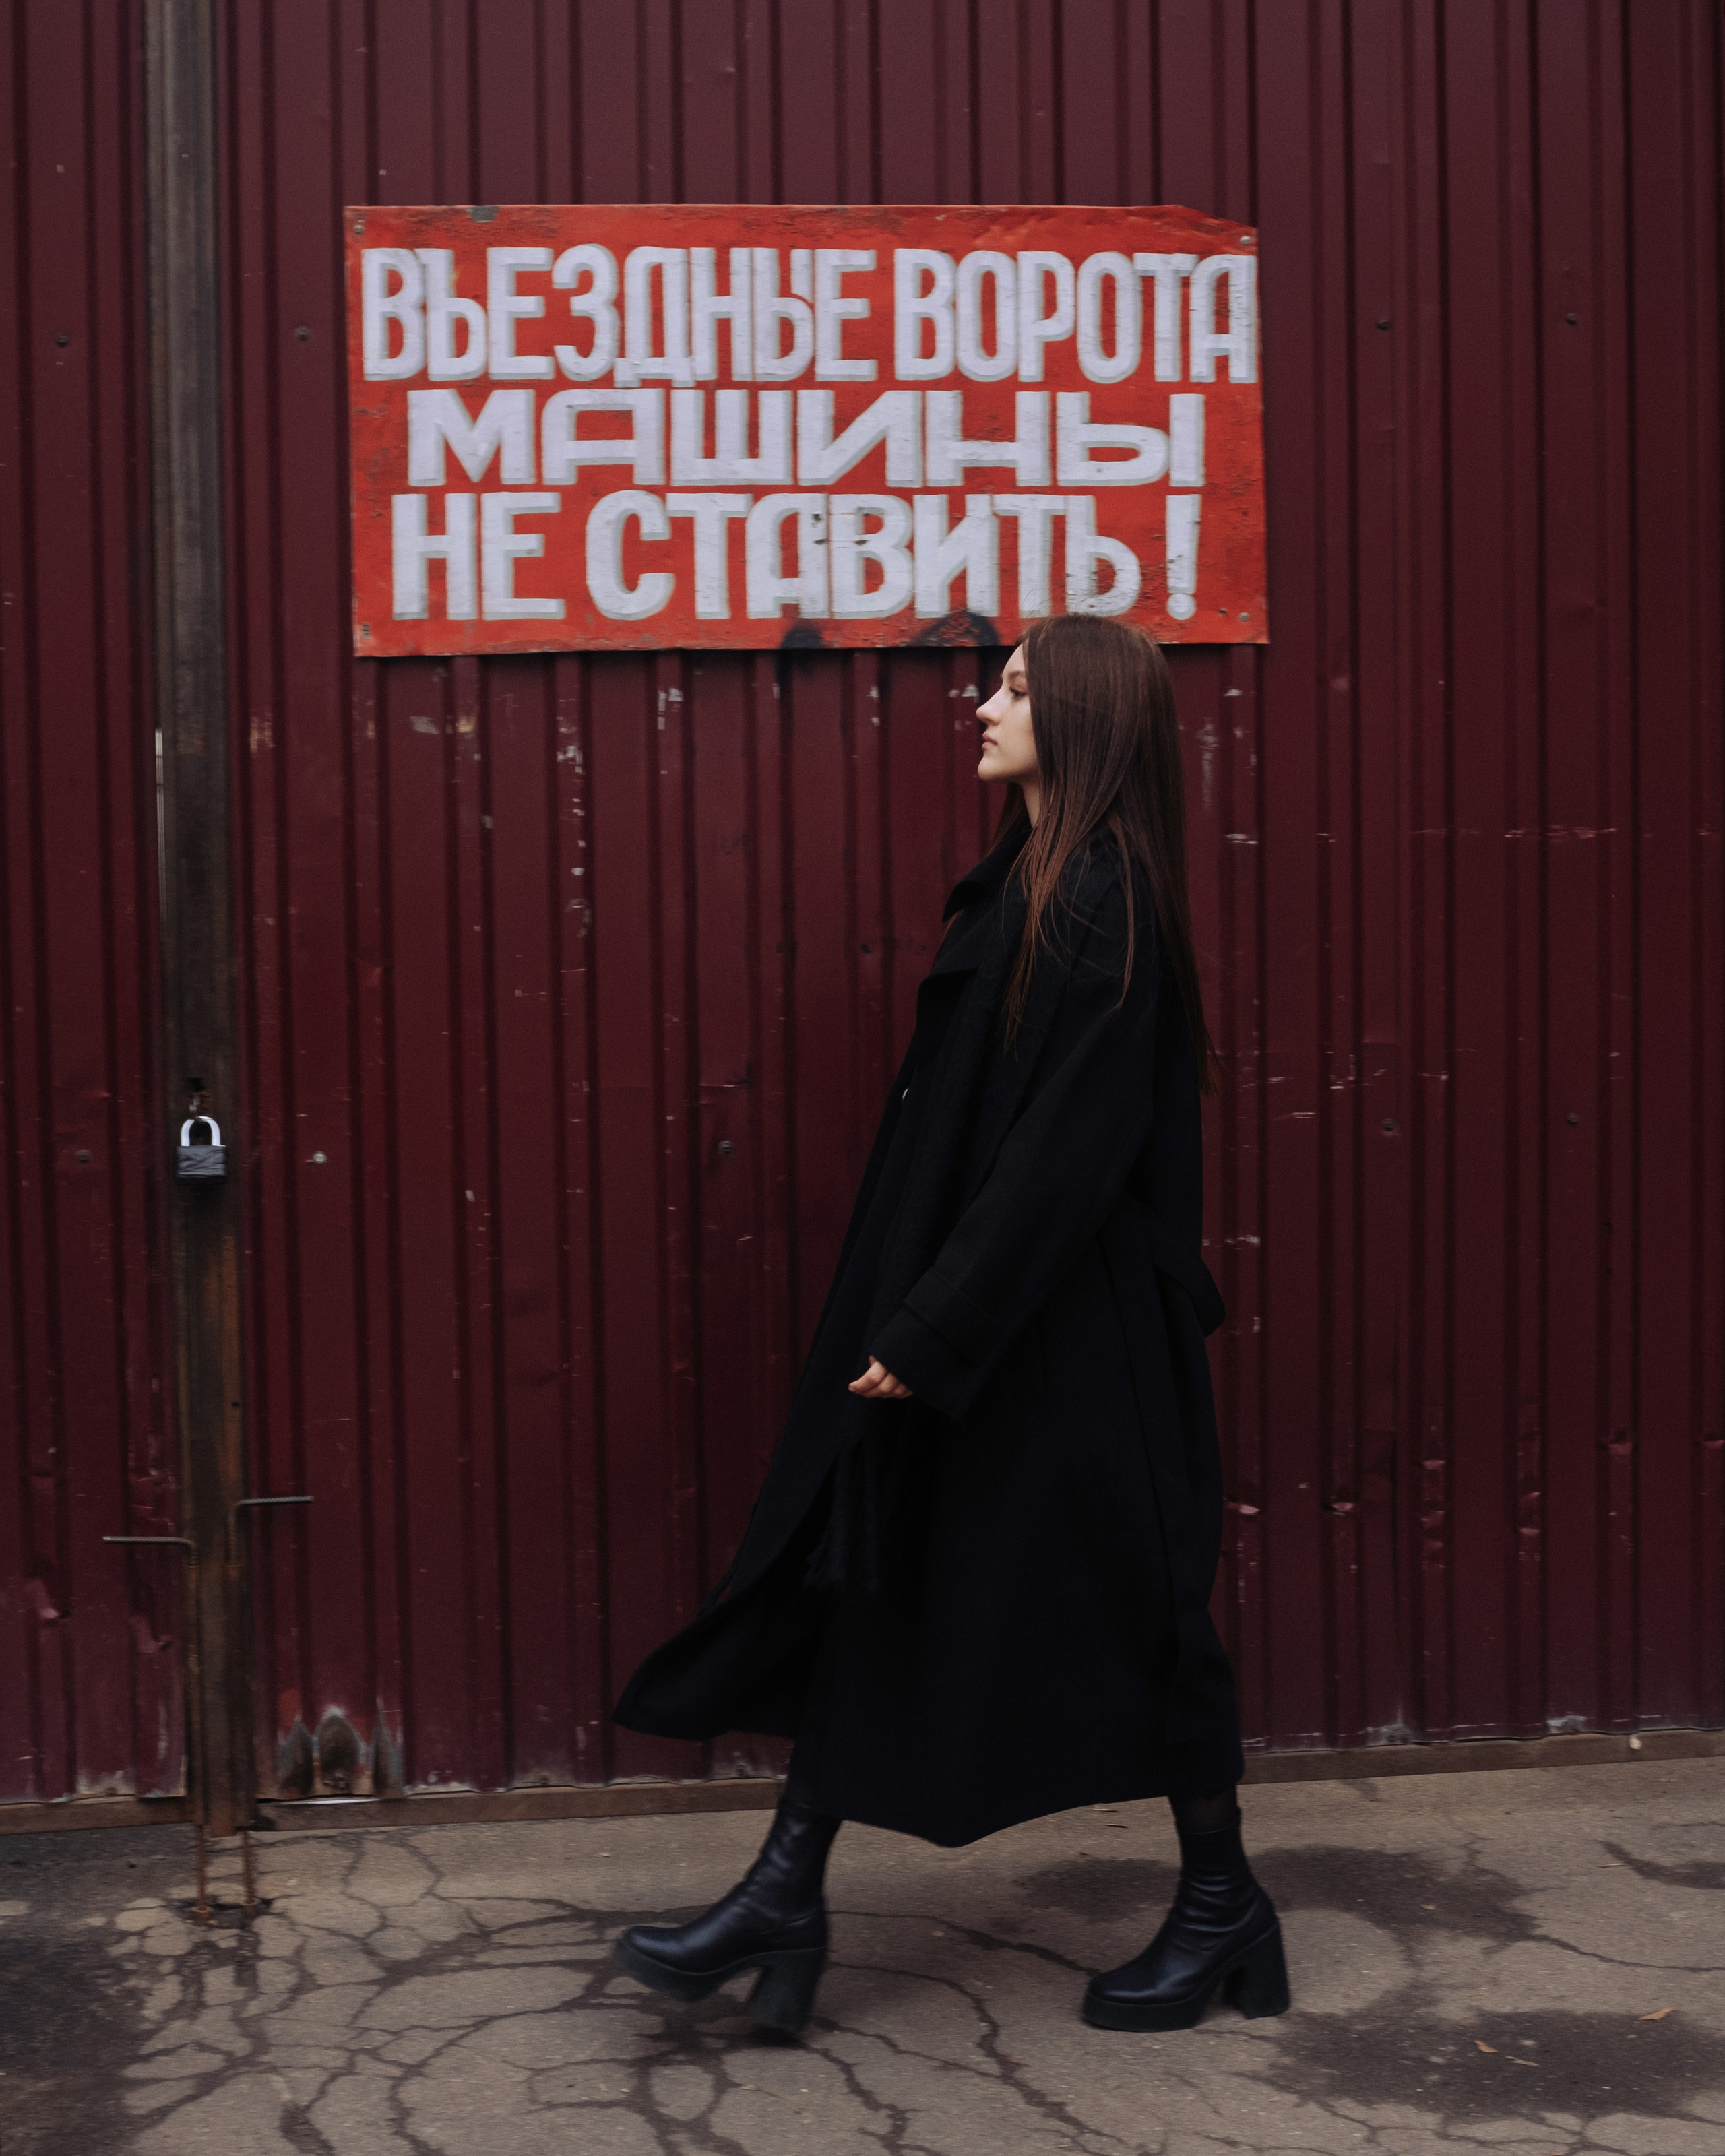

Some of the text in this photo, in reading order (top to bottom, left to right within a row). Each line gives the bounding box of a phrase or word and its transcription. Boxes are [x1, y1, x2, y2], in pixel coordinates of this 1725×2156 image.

[893, 248, 1259, 385] ВОРОТА
[406, 387, 1206, 488] МАШИНЫ
[391, 491, 567, 621] НЕ
